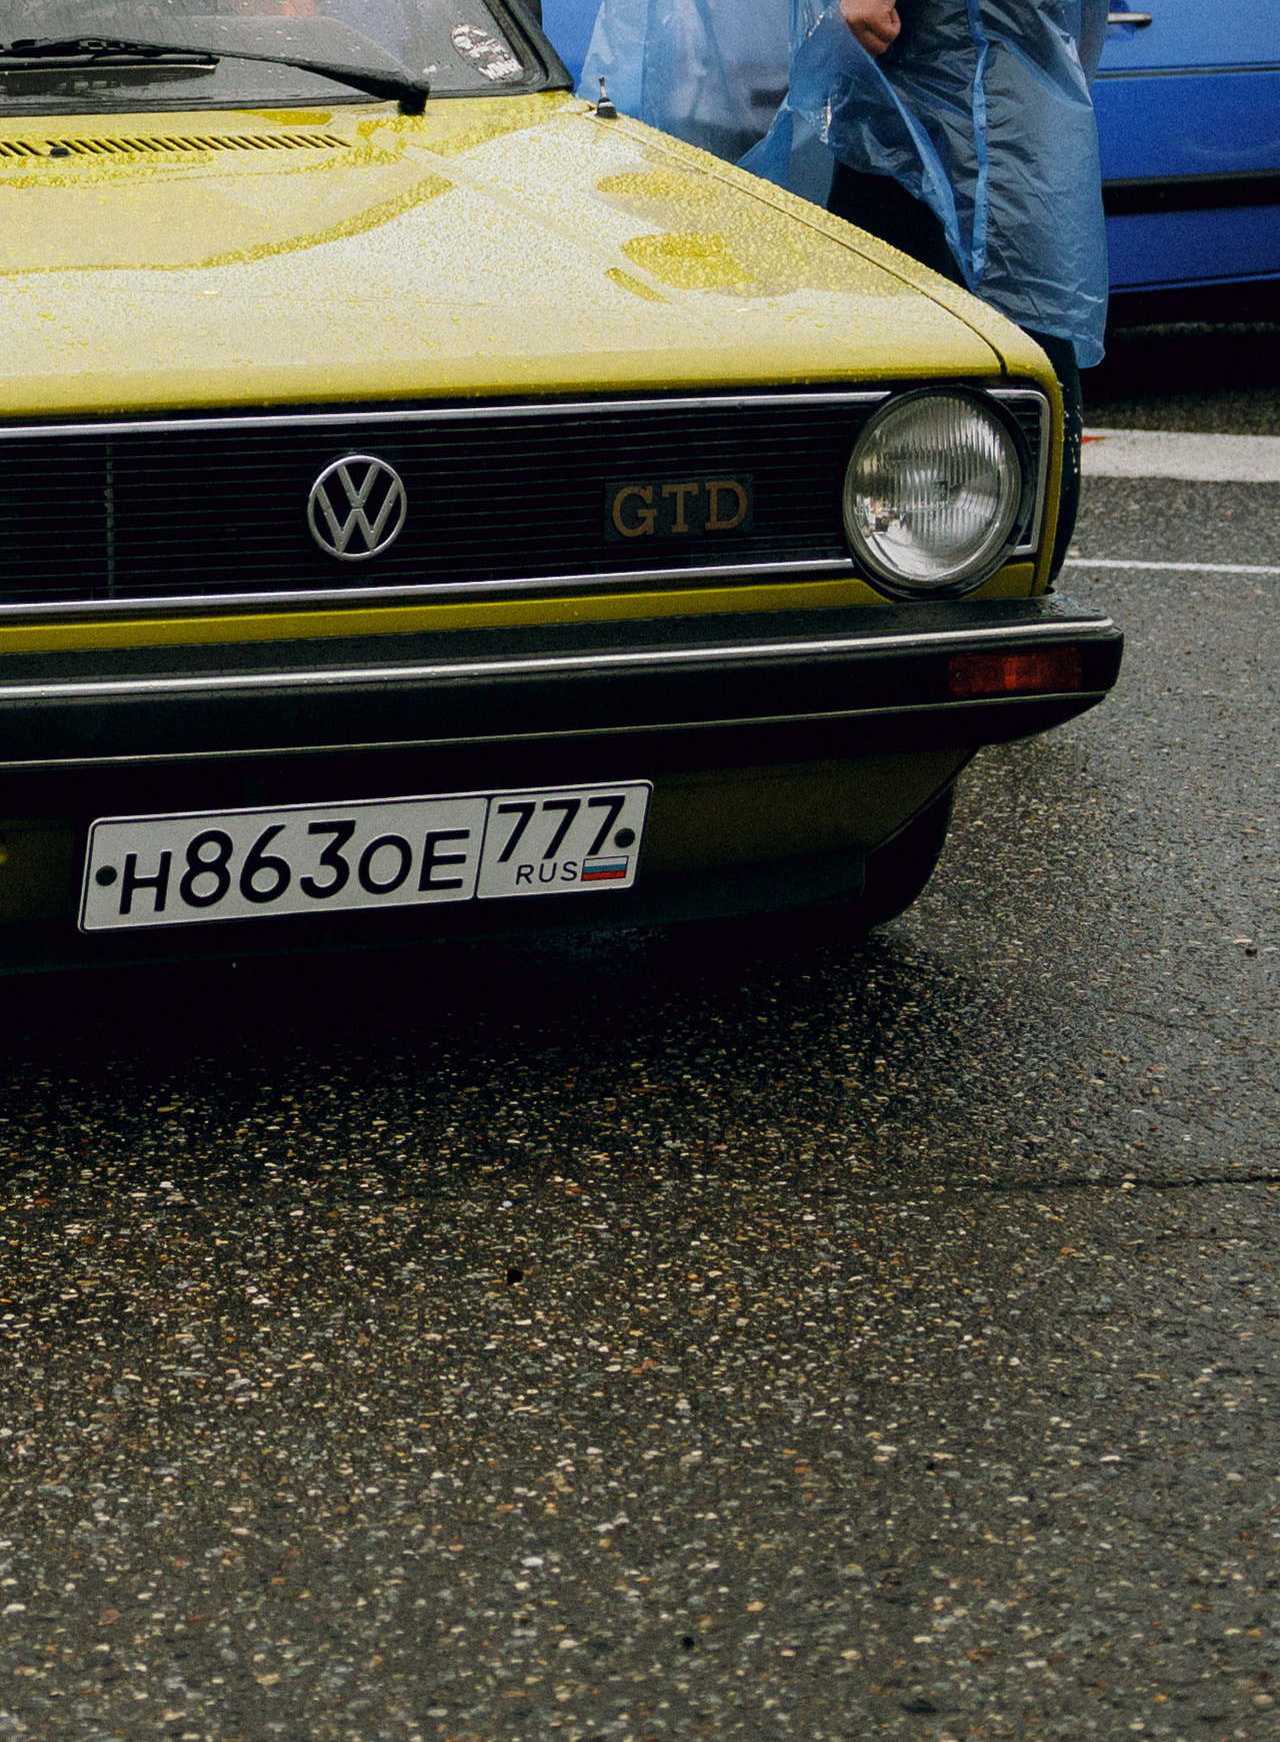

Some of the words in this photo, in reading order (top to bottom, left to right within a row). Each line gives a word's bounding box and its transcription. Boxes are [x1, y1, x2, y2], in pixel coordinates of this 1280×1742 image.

[309, 456, 406, 559] VW
[611, 480, 749, 538] GTD
[496, 794, 626, 863] 777
[515, 860, 579, 886] RUS
